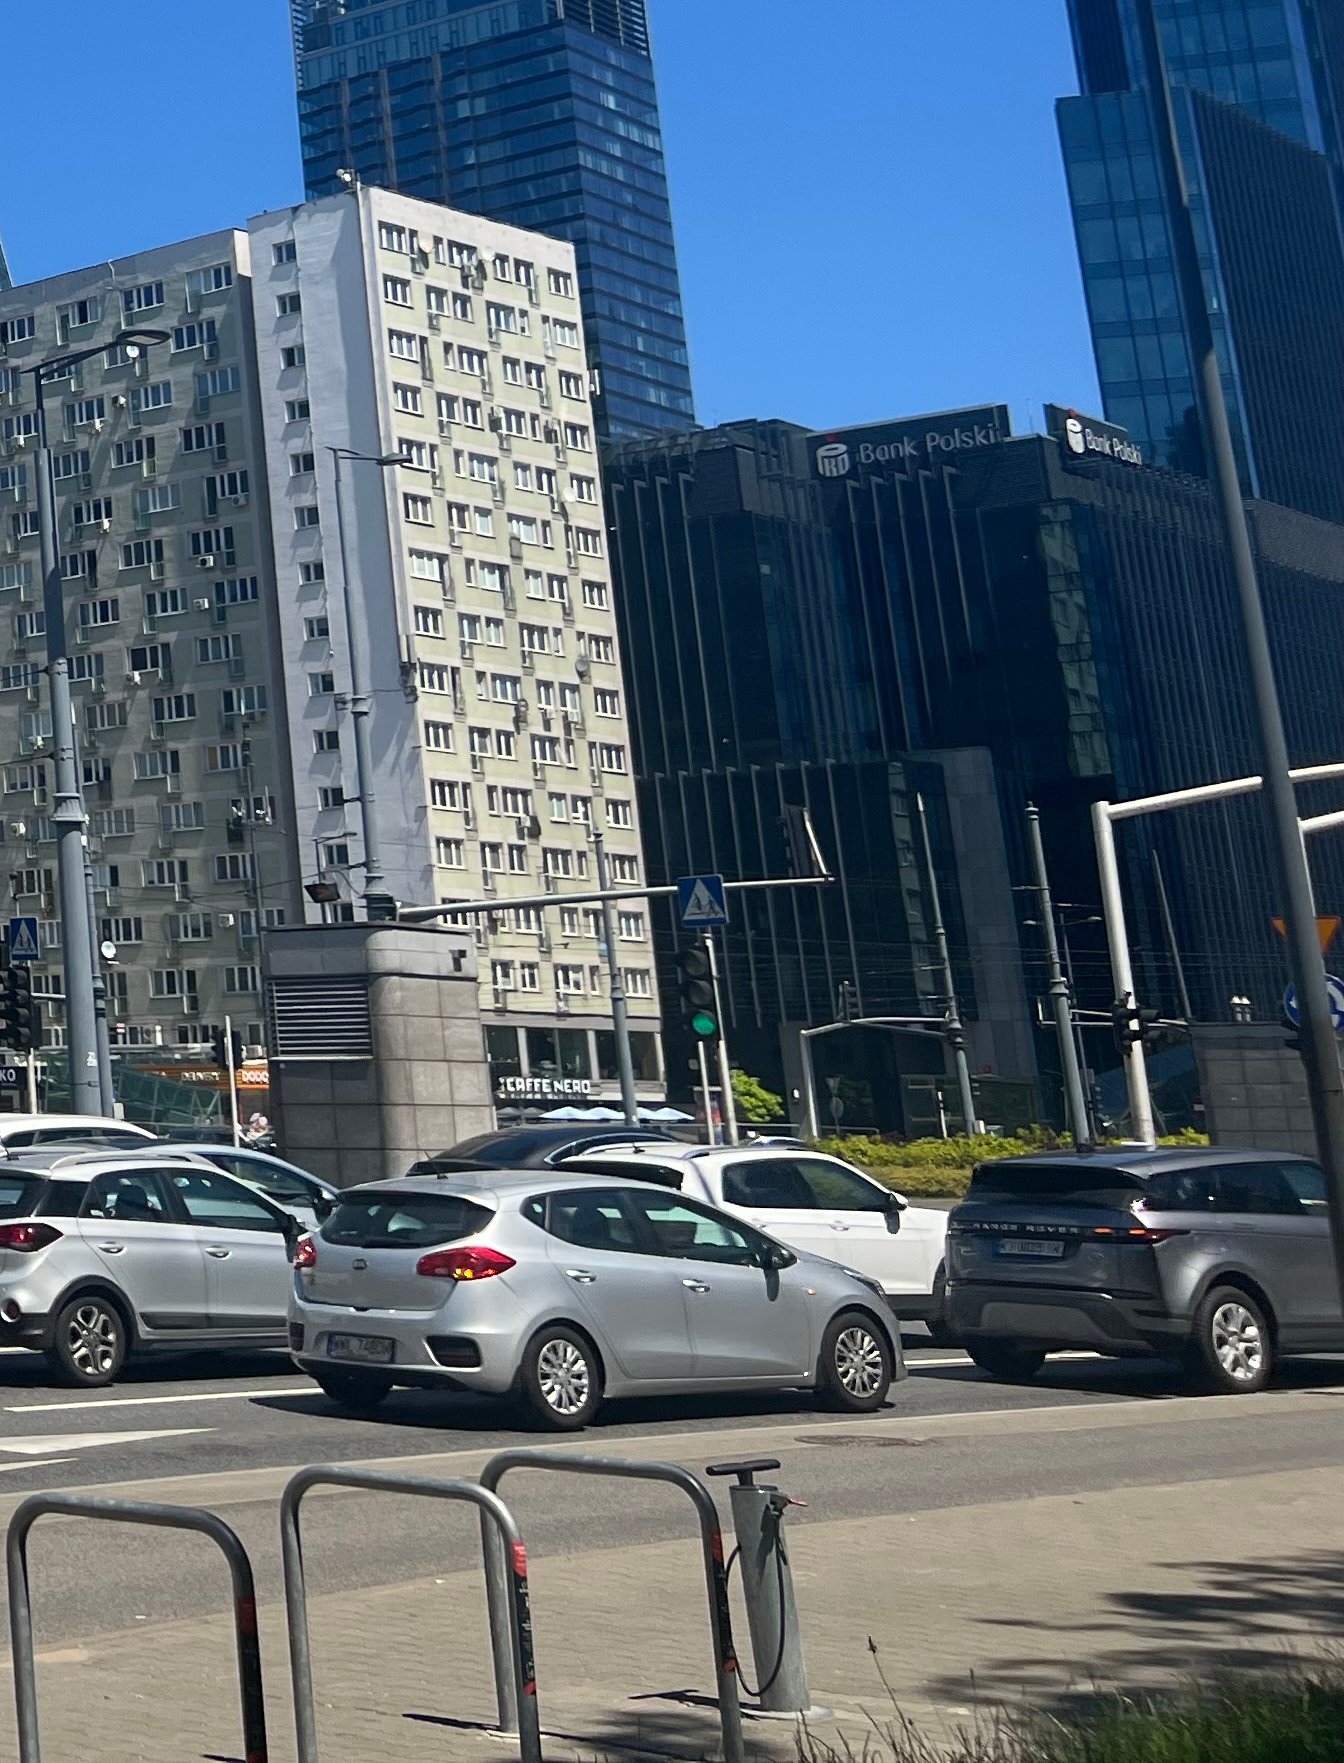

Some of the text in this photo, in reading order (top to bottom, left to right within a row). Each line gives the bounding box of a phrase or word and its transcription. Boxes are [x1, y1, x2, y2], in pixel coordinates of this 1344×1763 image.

[859, 437, 918, 464] Bank
[925, 422, 996, 454] Polski
[1085, 427, 1143, 466] Bank Polski
[553, 1079, 591, 1094] NERO
